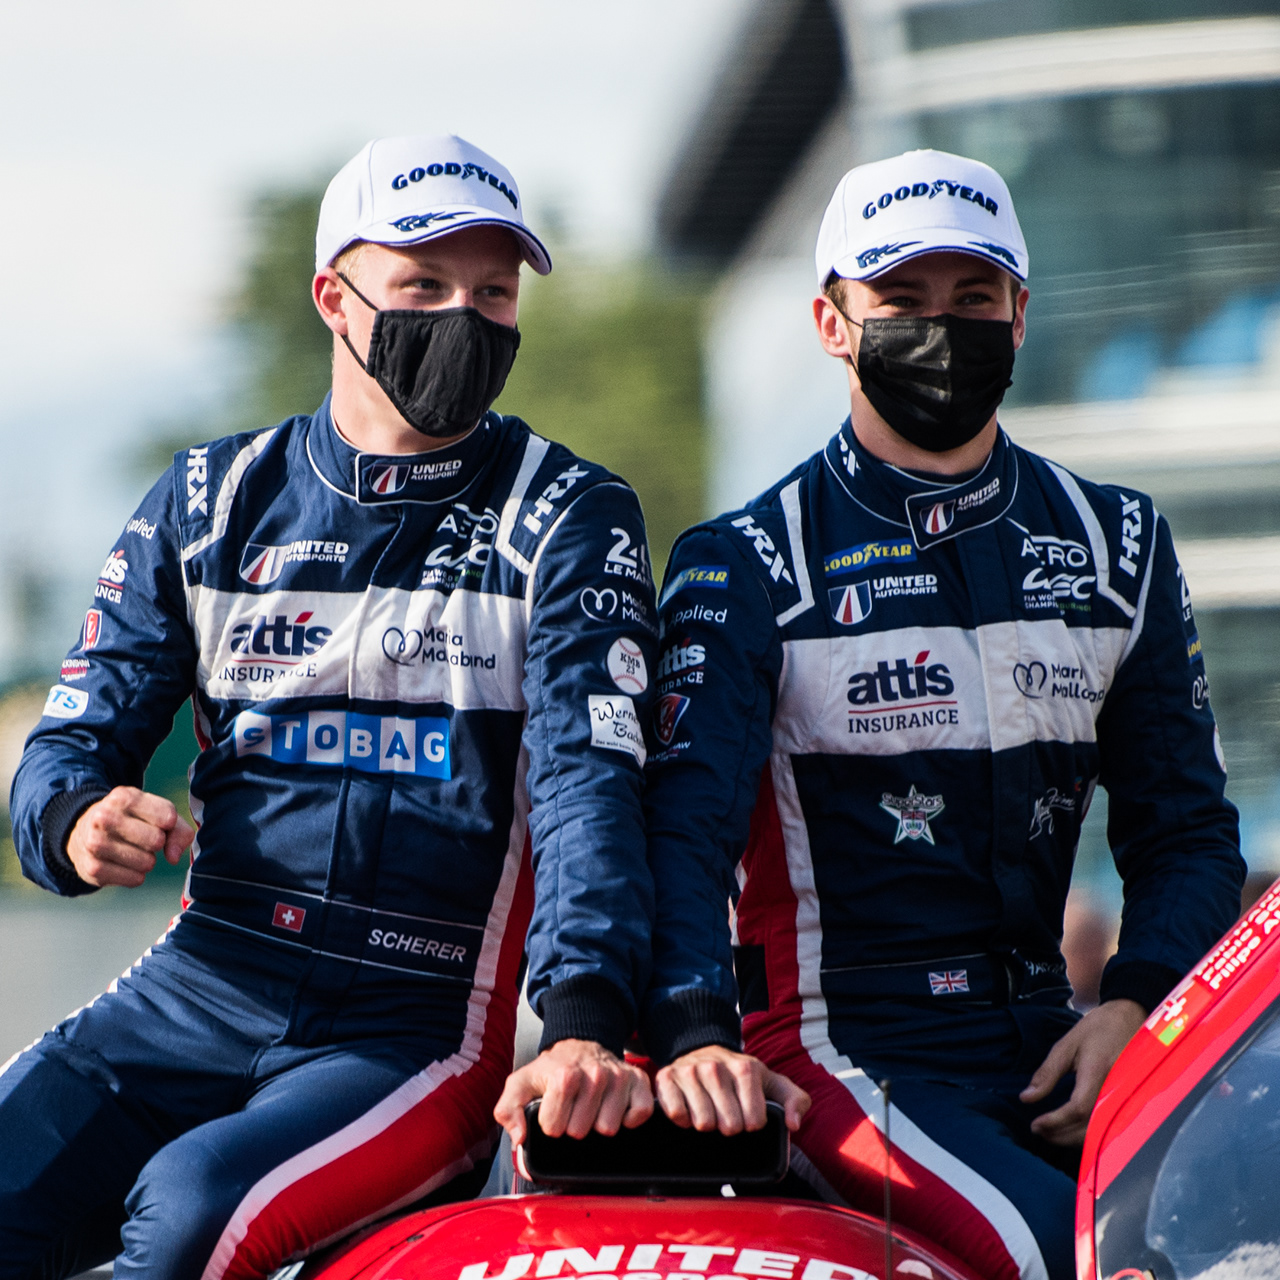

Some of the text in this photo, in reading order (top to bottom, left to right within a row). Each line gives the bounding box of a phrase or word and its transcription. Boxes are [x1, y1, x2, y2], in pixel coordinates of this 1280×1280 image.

[862, 179, 999, 220] GOODYEAR
[187, 447, 209, 516] HRX
[411, 460, 463, 475] UNITED
[523, 464, 590, 535] HRX
[958, 477, 1000, 506] UNITED
[731, 515, 794, 585] HRX
[604, 563, 623, 575] LE
[872, 573, 938, 591] UNITED
[874, 585, 938, 599] AUTOSPORTS
[230, 611, 333, 656] attis
[620, 652, 641, 669] KMB
[626, 664, 636, 675] 23
[847, 649, 956, 705] attis
[848, 709, 959, 734] INSURANCE
[243, 720, 446, 763] STOBAG
[368, 928, 467, 963] SCHERER
